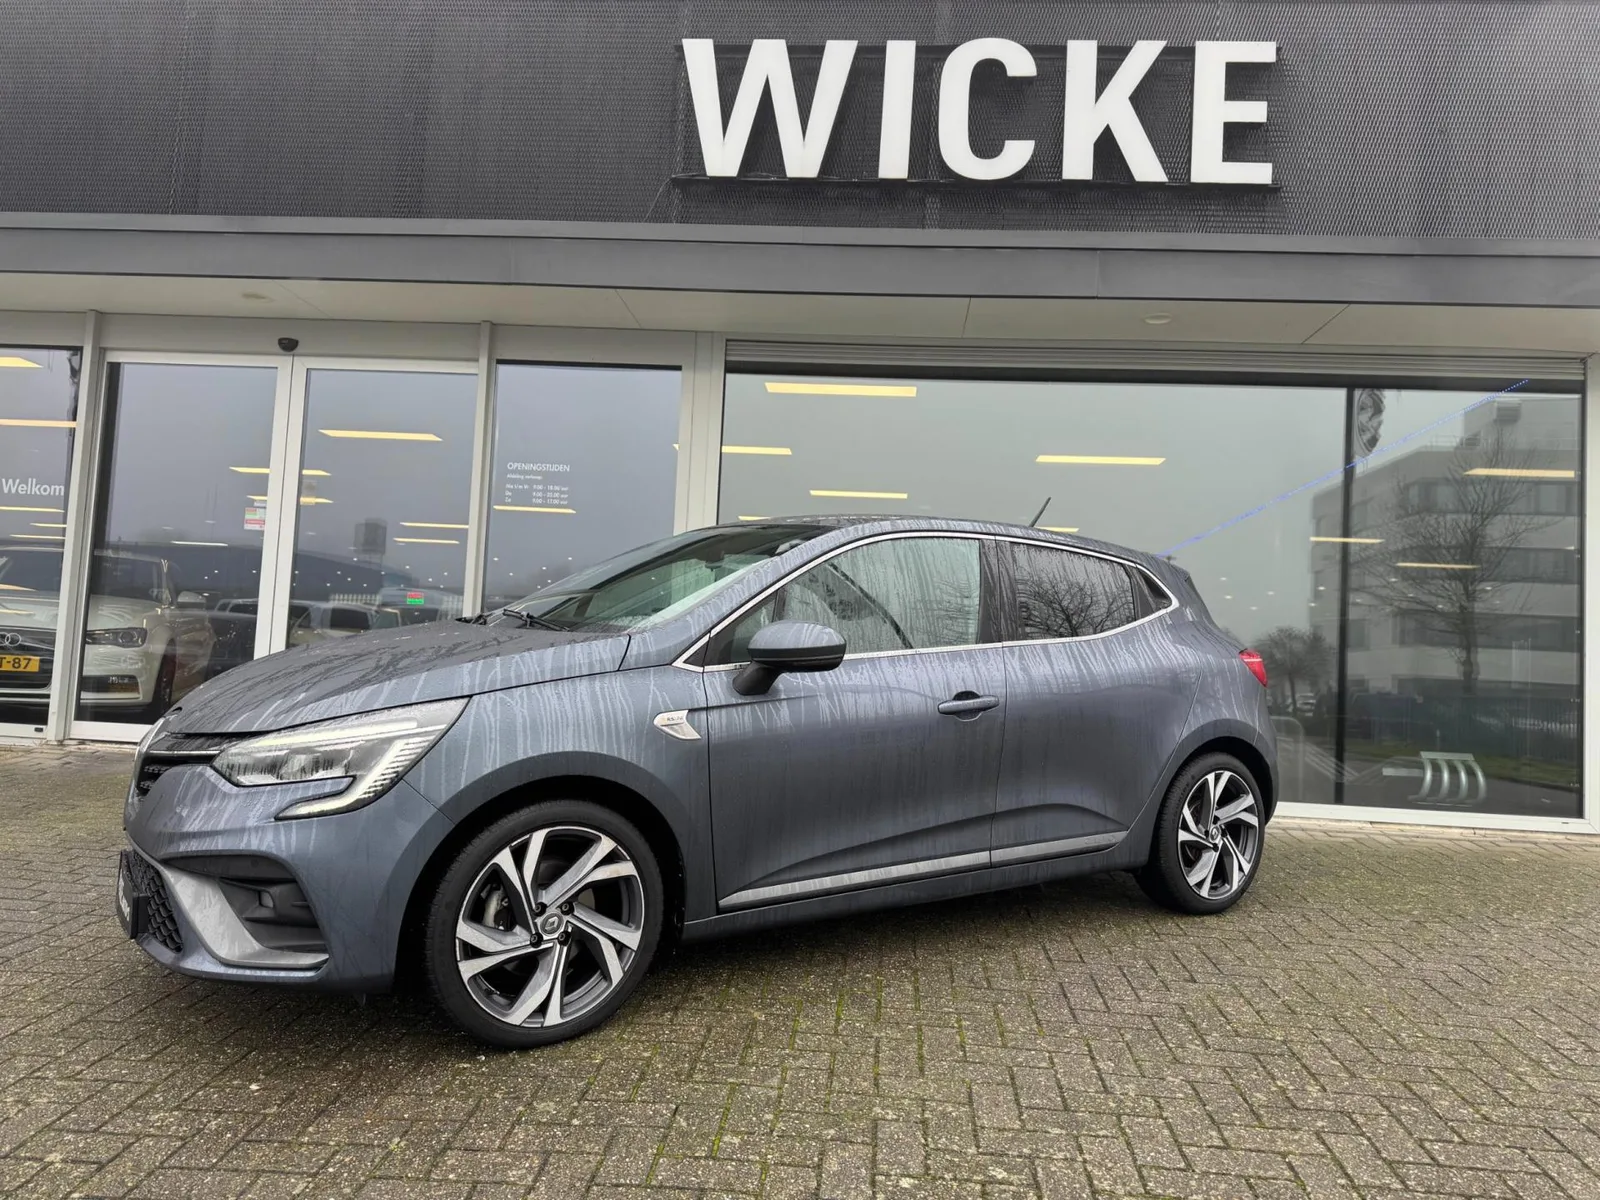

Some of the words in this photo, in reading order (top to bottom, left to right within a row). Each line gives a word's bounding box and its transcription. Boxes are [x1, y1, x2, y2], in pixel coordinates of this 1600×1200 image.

[682, 38, 1277, 184] WICKE
[507, 462, 570, 472] OPENINGSTIJDEN
[2, 478, 65, 496] Welkom
